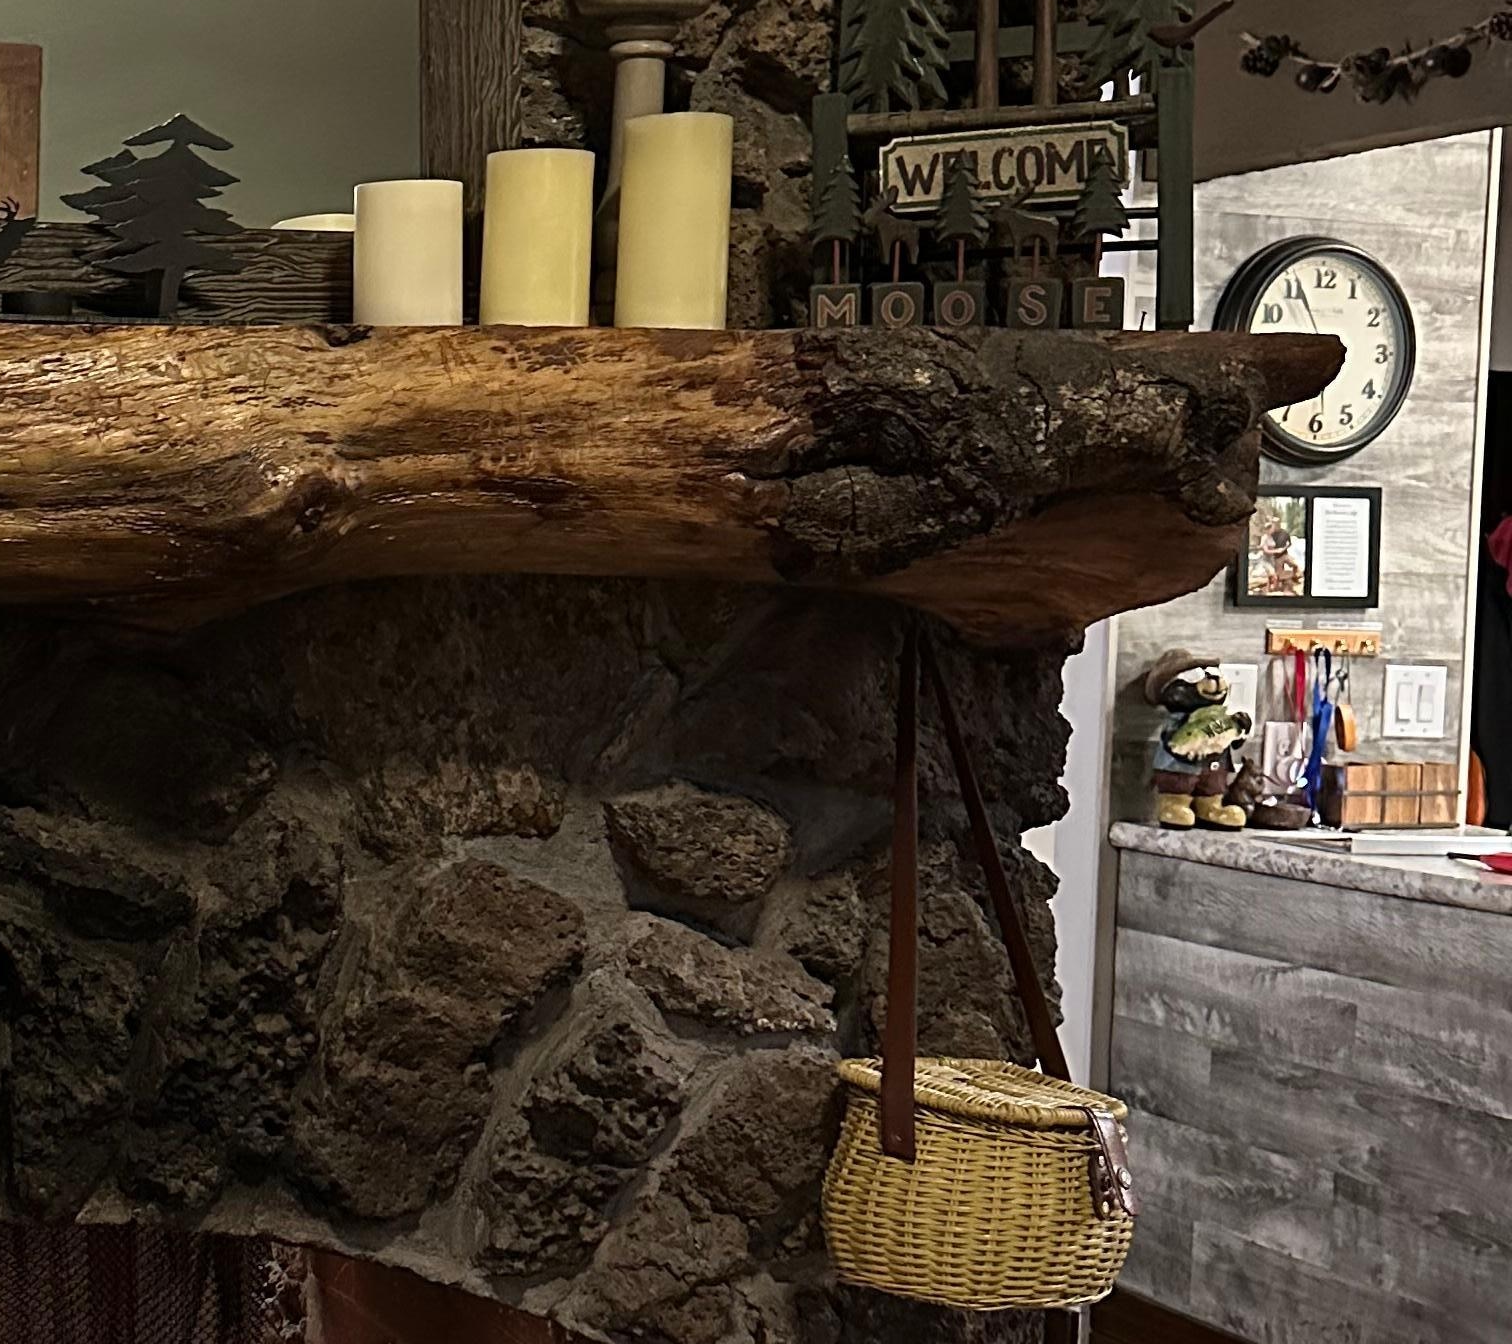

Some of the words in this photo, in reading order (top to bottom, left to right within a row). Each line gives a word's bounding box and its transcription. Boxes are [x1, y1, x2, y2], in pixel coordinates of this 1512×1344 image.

[1284, 278, 1302, 300] 11
[1314, 268, 1337, 289] 12
[1348, 279, 1358, 300] 1
[816, 284, 1113, 330] MOOSE
[1262, 303, 1284, 324] 10
[1367, 308, 1381, 327] 2
[1375, 344, 1388, 364] 3
[1361, 379, 1376, 399] 4
[1309, 413, 1323, 433] 6
[1339, 404, 1354, 425] 5
